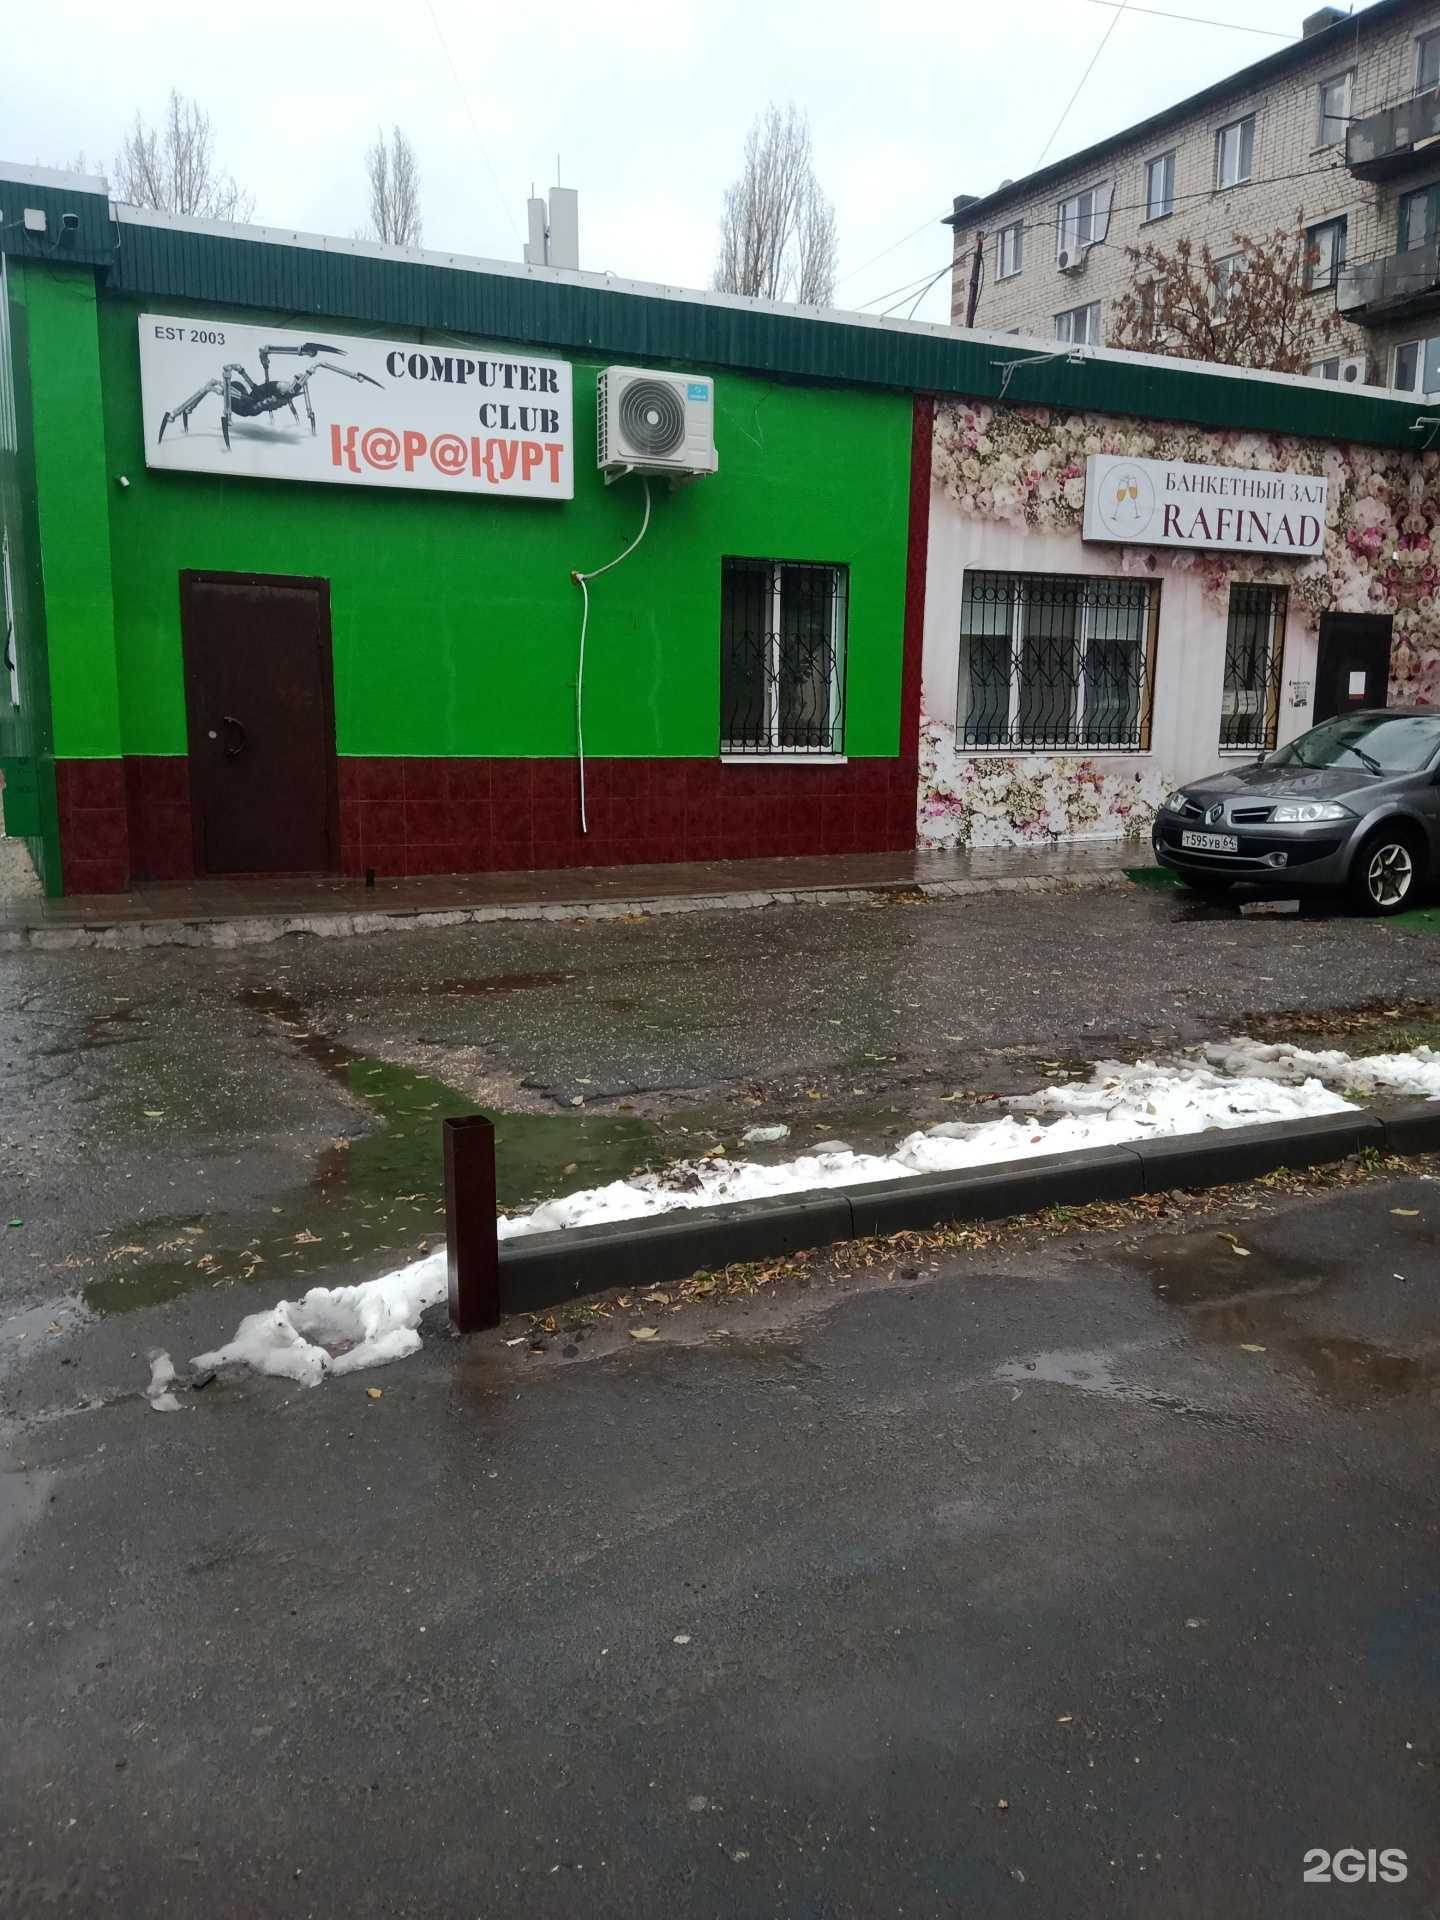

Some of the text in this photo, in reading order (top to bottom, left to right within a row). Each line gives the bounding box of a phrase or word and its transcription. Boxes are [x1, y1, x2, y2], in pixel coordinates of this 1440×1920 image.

[154, 326, 226, 346] EST 2003
[386, 351, 560, 394] COMPUTER
[479, 402, 560, 434] CLUB
[1166, 472, 1325, 504] БАНКЕТНЫЙ ЗАЛ
[1163, 503, 1321, 547] RAFINAD
